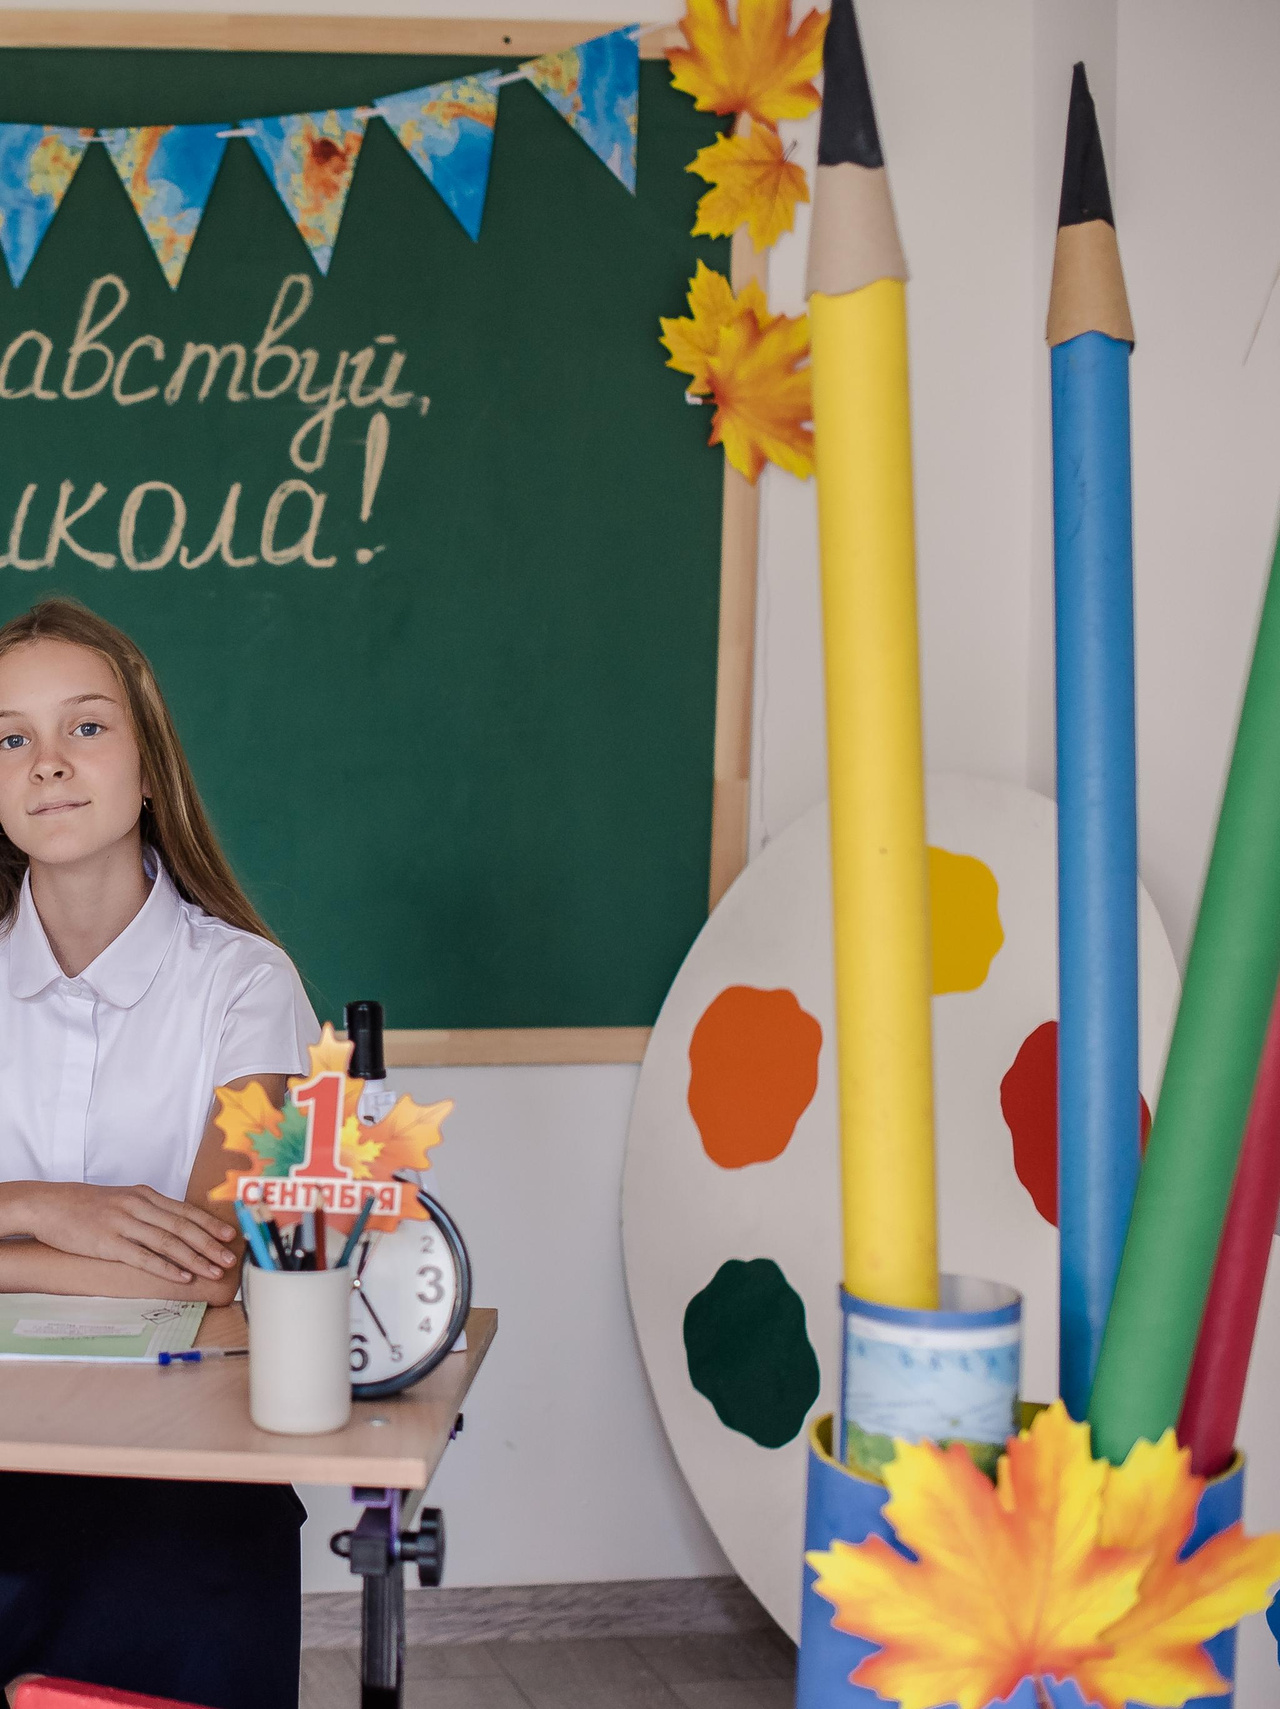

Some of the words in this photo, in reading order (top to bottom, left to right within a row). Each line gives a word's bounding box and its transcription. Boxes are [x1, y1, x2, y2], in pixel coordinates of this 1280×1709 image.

[293, 1073, 348, 1179] 1
[241, 1181, 396, 1211] СЕНТЯБРЯ
[421, 1236, 435, 1254] 2
[416, 1265, 445, 1304] 3
[418, 1317, 432, 1333] 4
[390, 1343, 404, 1363] 5
